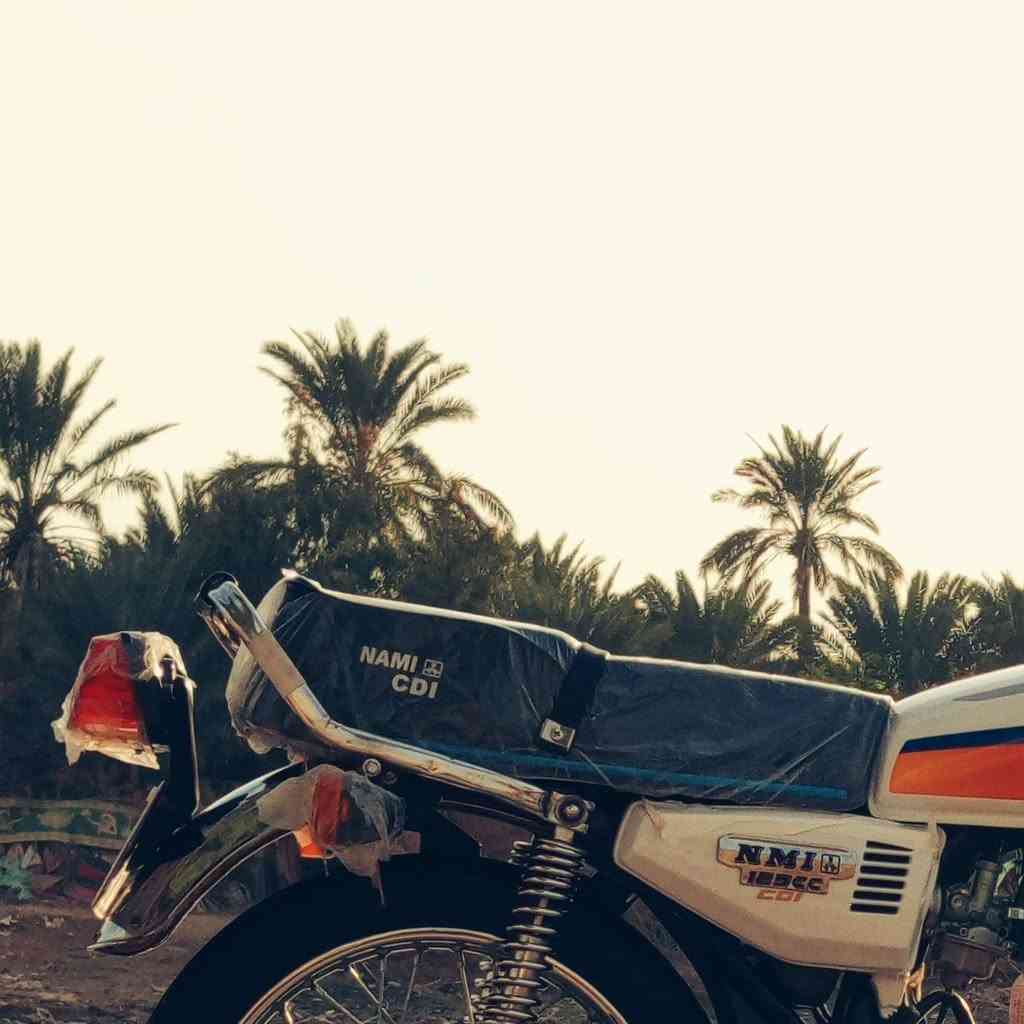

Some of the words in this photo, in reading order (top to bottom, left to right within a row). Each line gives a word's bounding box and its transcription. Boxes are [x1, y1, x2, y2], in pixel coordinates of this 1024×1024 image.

[360, 645, 418, 673] NAMI
[391, 674, 439, 698] CDI
[735, 843, 817, 872] NMI
